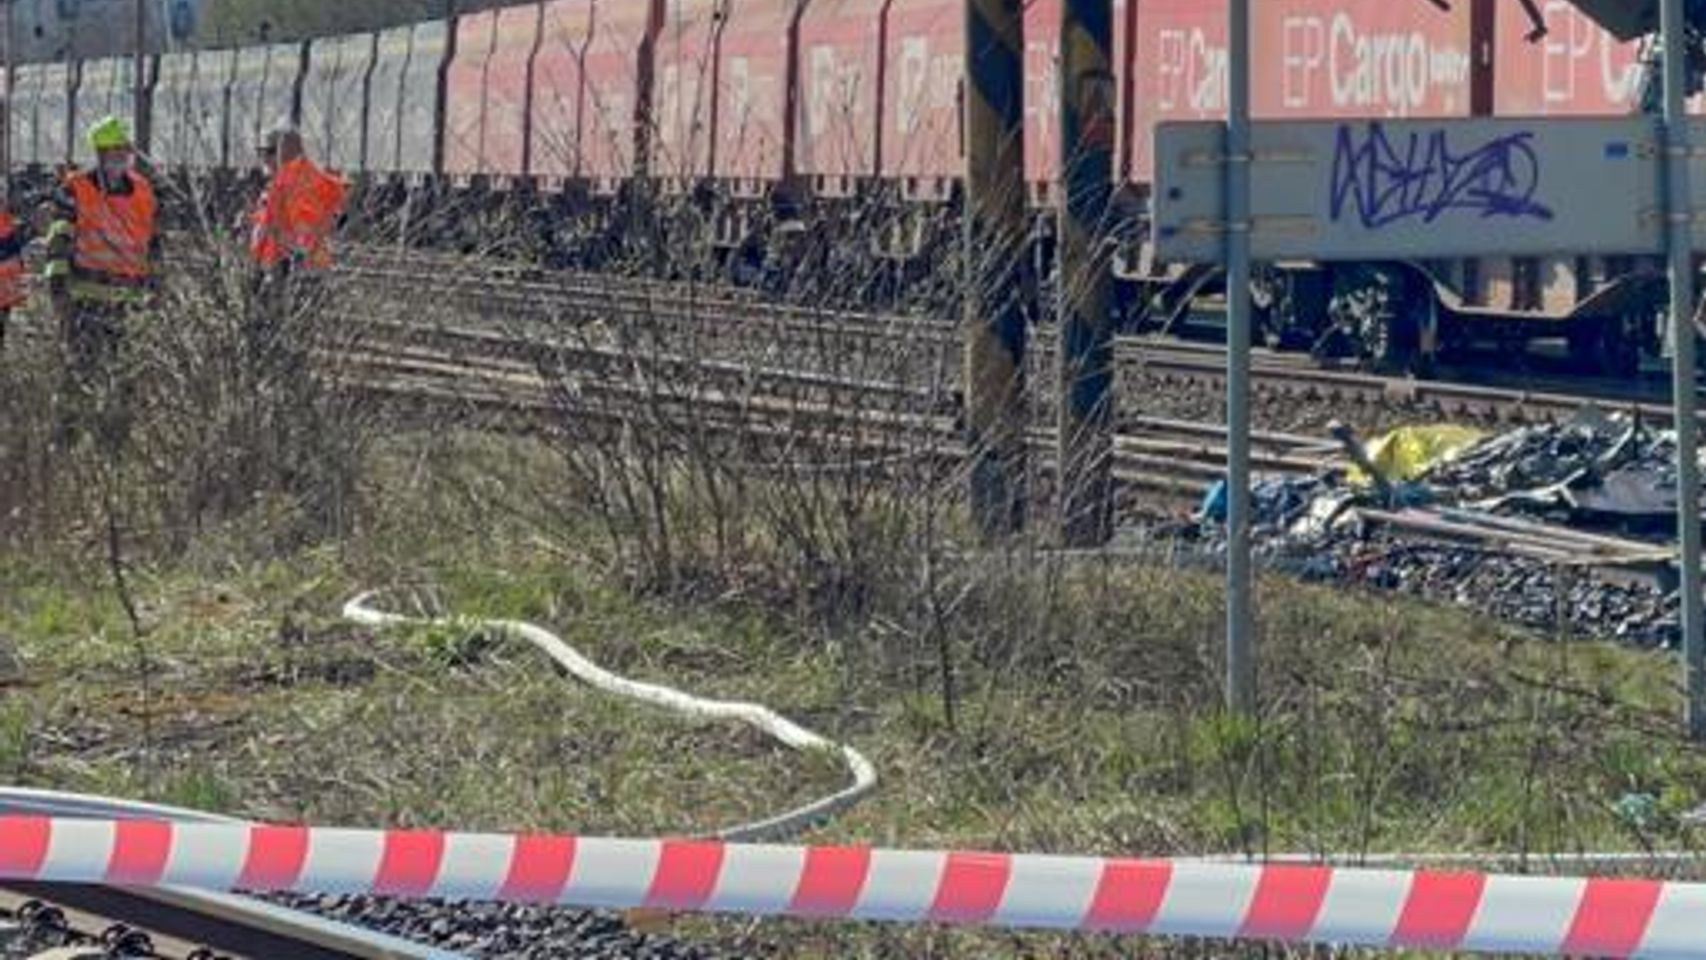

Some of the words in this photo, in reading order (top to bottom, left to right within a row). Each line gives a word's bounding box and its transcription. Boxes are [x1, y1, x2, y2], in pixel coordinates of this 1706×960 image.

[1187, 26, 1230, 118] Car
[1283, 16, 1325, 108] EP
[1330, 13, 1427, 117] Cargo
